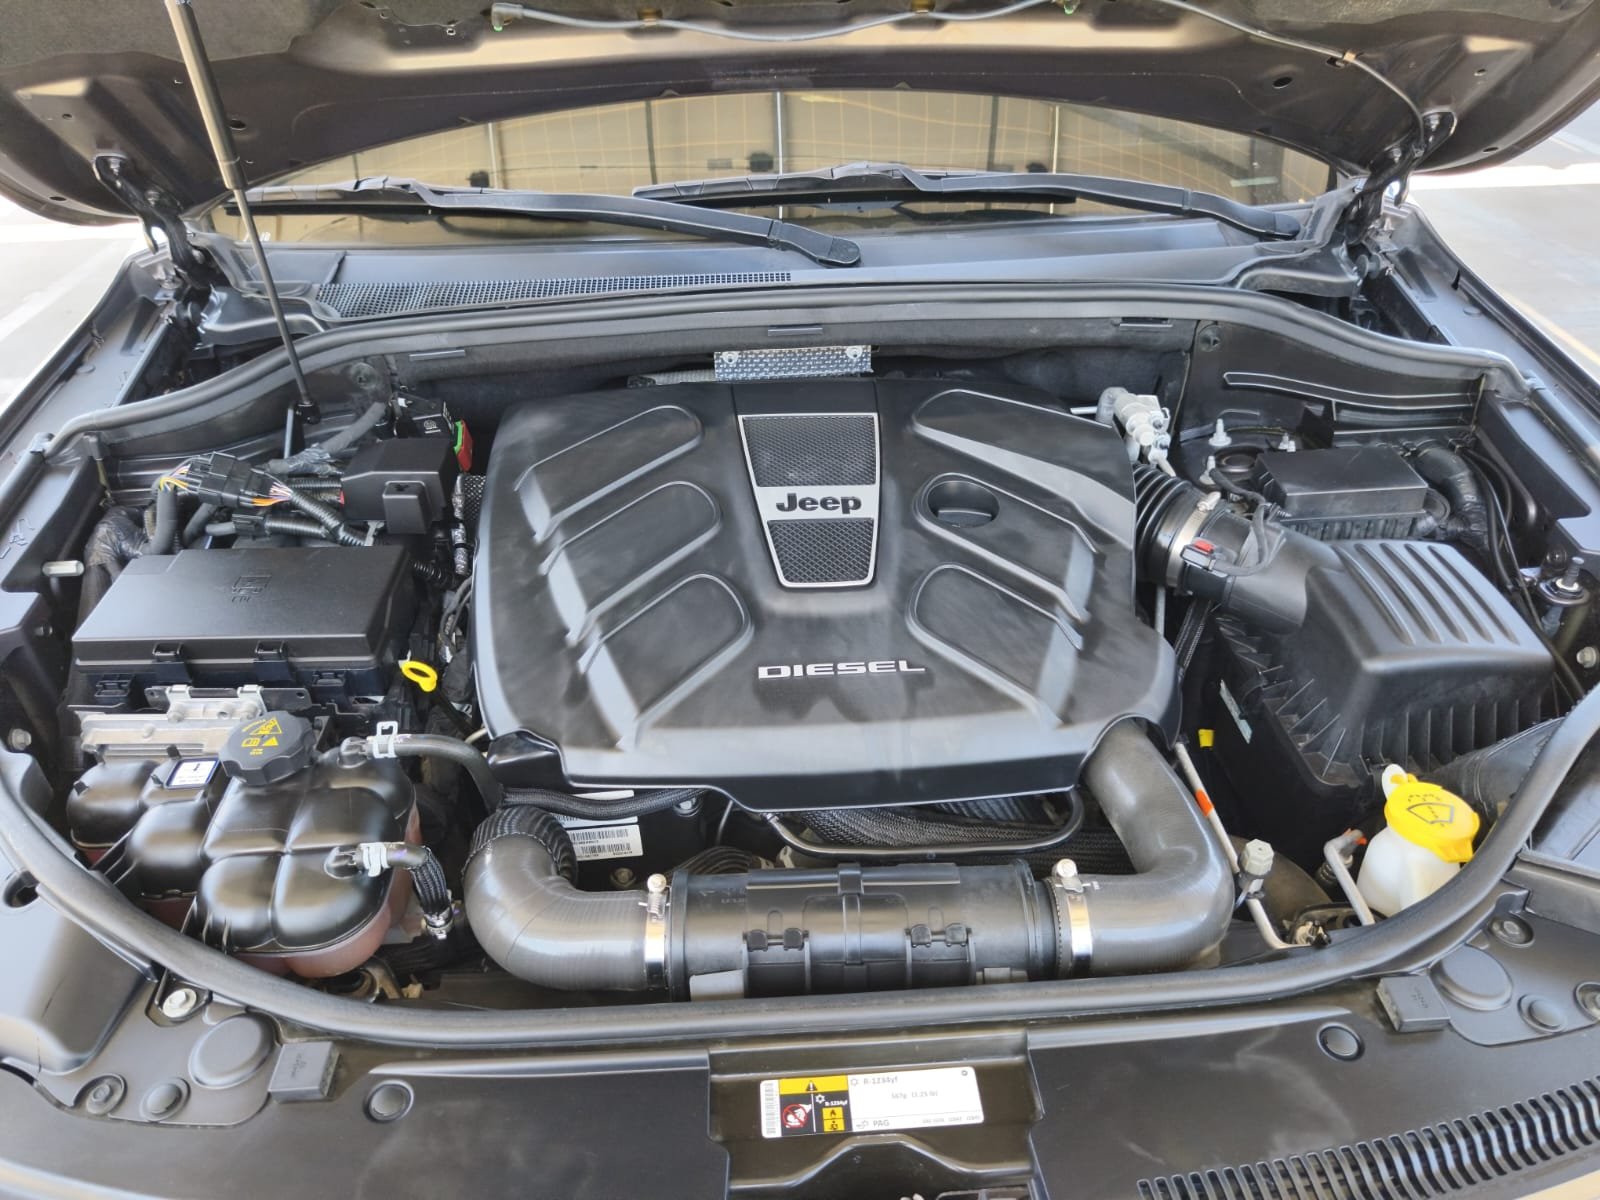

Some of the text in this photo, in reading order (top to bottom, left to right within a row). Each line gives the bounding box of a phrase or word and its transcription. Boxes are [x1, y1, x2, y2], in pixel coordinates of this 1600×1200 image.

[776, 492, 862, 514] Jeep
[758, 660, 926, 679] DIESEL
[873, 1119, 890, 1127] PAG
